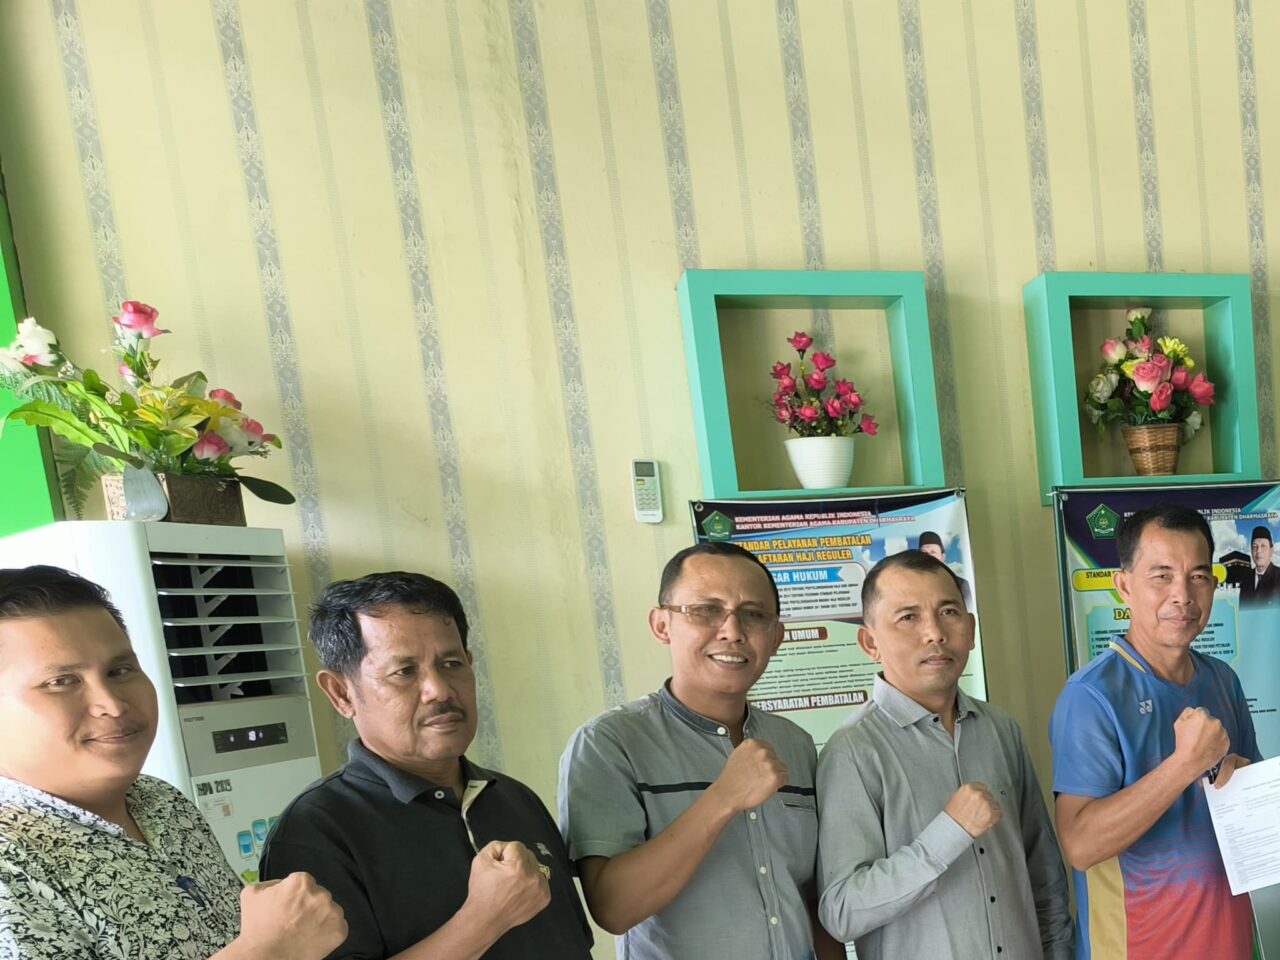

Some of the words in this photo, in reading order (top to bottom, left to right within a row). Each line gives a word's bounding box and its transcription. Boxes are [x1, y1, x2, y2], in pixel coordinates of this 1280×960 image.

[735, 514, 780, 523] KEMENTERIAN
[781, 513, 804, 521] AGAMA
[805, 512, 836, 520] REPUBLIK
[736, 522, 762, 530] KANTOR
[764, 520, 809, 529] KEMENTERIAN
[772, 537, 818, 549] PELAYANAN
[820, 535, 872, 548] PEMBATALAN
[757, 553, 794, 564] AFTARAN
[796, 552, 814, 562] HAJI
[816, 550, 853, 561] REGULER
[792, 570, 828, 582] HUKUM
[1086, 570, 1111, 579] STANDAR
[792, 628, 819, 640] UMUM
[811, 692, 864, 706] PEMBATALAN
